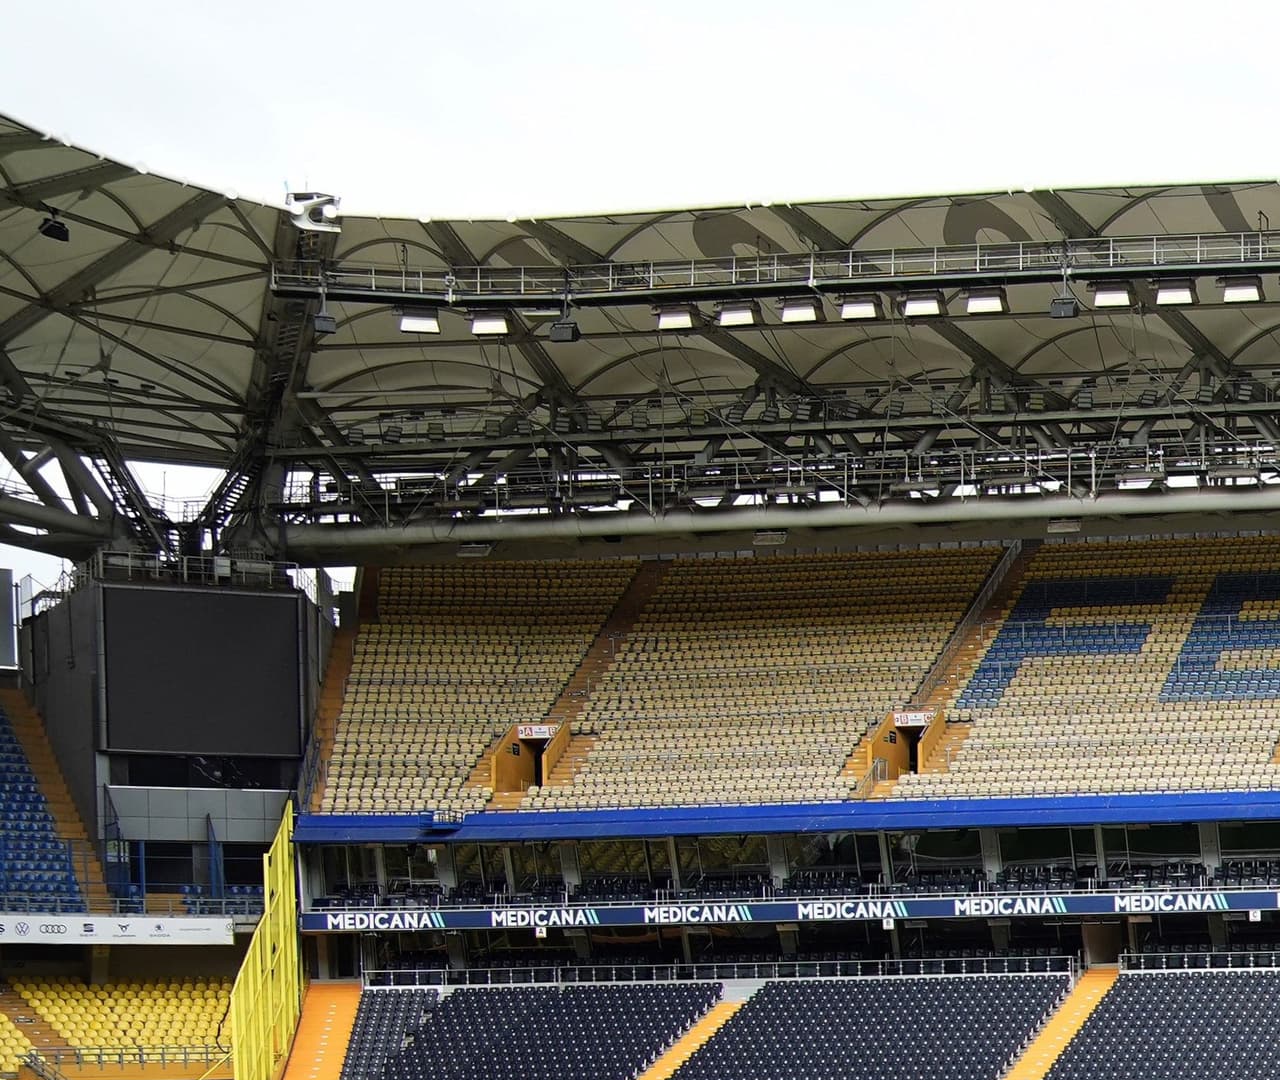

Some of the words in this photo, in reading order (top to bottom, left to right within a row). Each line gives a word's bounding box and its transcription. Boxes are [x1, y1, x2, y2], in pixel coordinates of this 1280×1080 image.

[799, 902, 895, 918] MEDICANA
[954, 897, 1054, 915] MEDICANA
[1114, 895, 1217, 912] MEDICANA
[327, 913, 432, 930] MEDICANA
[491, 909, 587, 927] MEDICANA
[644, 905, 739, 923] MEDICANA
